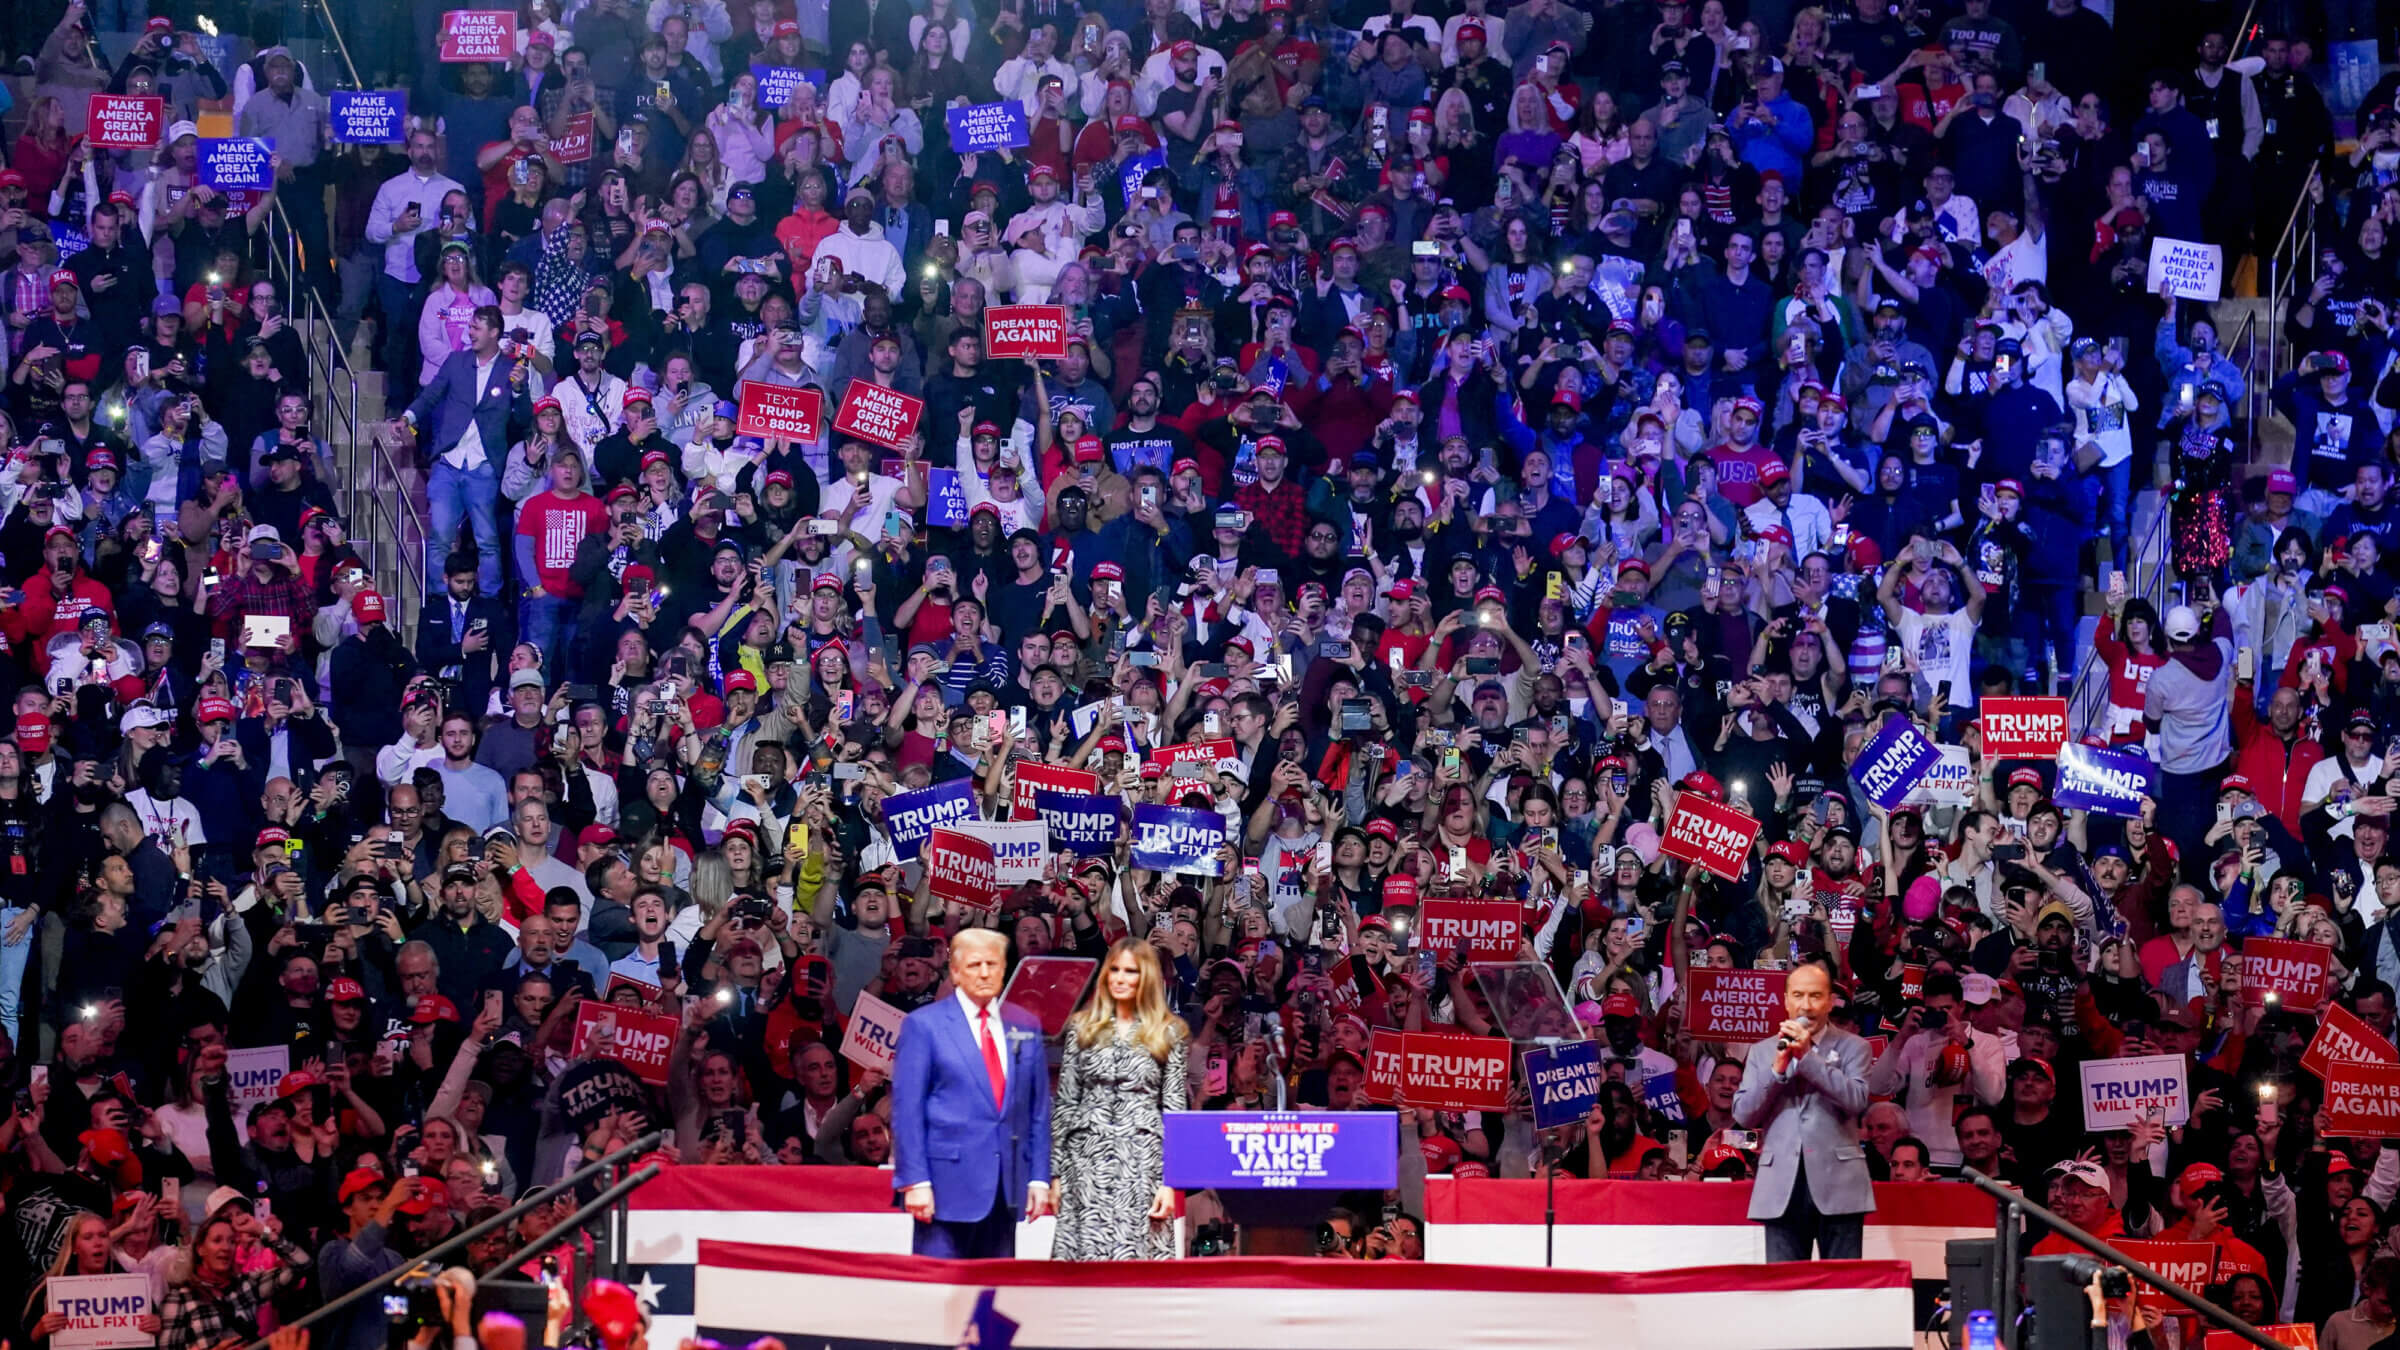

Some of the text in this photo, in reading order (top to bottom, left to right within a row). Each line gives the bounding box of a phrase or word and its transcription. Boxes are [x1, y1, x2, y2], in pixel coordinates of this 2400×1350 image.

[460, 16, 496, 25] MAKE
[450, 25, 507, 35] AMERICA
[1951, 29, 2001, 45] TOO BIG
[457, 35, 499, 45] GREAT
[456, 44, 500, 55] AGAIN!
[764, 95, 791, 104] AGA
[766, 88, 793, 97] GRE
[107, 100, 144, 111] MAKE
[350, 96, 386, 106] MAKE
[96, 109, 154, 121] AMERICA
[340, 106, 396, 116] AMERICA
[968, 106, 1004, 118] MAKE
[103, 121, 147, 131] GREAT
[347, 116, 389, 126] GREAT
[959, 114, 1016, 128] AMERICA
[101, 131, 147, 142] AGAIN!
[346, 126, 389, 137] AGAIN!
[967, 124, 1009, 135] GREAT
[968, 132, 1012, 145] AGAIN!
[217, 143, 254, 153] MAKE
[207, 153, 265, 163] AMERICA
[215, 163, 258, 174] GREAT
[214, 173, 260, 184] AGAIN!
[55, 238, 89, 252] AMER
[2172, 246, 2209, 260] MAKE
[2160, 255, 2215, 272] AMERICA
[2165, 266, 2208, 280] GREAT
[991, 319, 1061, 331] DREAM BIG,
[2335, 312, 2355, 326] 202
[995, 330, 1057, 344] AGAIN!
[765, 392, 799, 407] TEXT
[866, 388, 904, 408] MAKE
[757, 404, 805, 420] TRUMP
[852, 396, 909, 423] AMERICA
[747, 414, 811, 434] TO 88022
[856, 408, 898, 431] GREAT
[850, 419, 897, 441] AGAIN!
[1110, 439, 1172, 452] FIGHT FIGHT
[1718, 460, 1758, 485] USA
[565, 511, 576, 560] TRUMP
[2123, 657, 2153, 682] US
[1984, 713, 2064, 732] TRUMP
[1986, 730, 2063, 743] WILL FIX IT
[1173, 746, 1214, 762] MAKE
[1859, 729, 1916, 789] TRUMP
[1220, 761, 1239, 773] USA
[1869, 740, 1927, 801] WILL FIX IT
[1928, 764, 1968, 780] UMP
[1934, 779, 1969, 790] FIX IT
[2062, 777, 2099, 796] WILL
[2102, 785, 2128, 800] FIX
[888, 797, 970, 832] TRUMP
[1038, 808, 1116, 831] TRUMP
[894, 828, 929, 843] WILL
[1070, 829, 1114, 842] FIX IT
[1138, 822, 1223, 846] TRUMP
[1676, 808, 1750, 850] TRUMP
[995, 841, 1041, 858] UMP
[1178, 845, 1205, 858] FIX
[1670, 825, 1742, 863] WILL FIX IT
[1770, 843, 1790, 854] USA
[935, 847, 996, 883] TRUMP
[1000, 858, 1041, 870] FIX IT
[933, 867, 996, 894] WILL FIX IT
[1426, 918, 1517, 938] TRUMP
[1427, 936, 1515, 951] WIL FIX IT
[2244, 955, 2322, 982] TRUMP
[1715, 975, 1766, 991] MAKE
[2241, 975, 2319, 995] WILL FIX IT
[1700, 990, 1780, 1006] AMERICA
[1710, 1004, 1769, 1020] GREAT
[859, 1015, 897, 1050] TRU
[1707, 1018, 1770, 1034] AGAIN!
[582, 1020, 670, 1054] TUMP
[854, 1031, 884, 1059] WILL
[621, 1048, 667, 1066] FIX IT
[1407, 1051, 1505, 1077] TRUMP
[233, 1068, 282, 1088] UMP
[1407, 1072, 1504, 1092] WILL FIX IT
[1535, 1063, 1586, 1086] DREAM
[243, 1086, 267, 1099] FIX
[2091, 1077, 2178, 1101] TRUMP
[2331, 1081, 2385, 1097] DREAM
[568, 1092, 606, 1117] WILL
[1443, 1100, 1464, 1108] 2024
[2092, 1098, 2131, 1113] WILL
[2162, 1094, 2178, 1108] IT
[1269, 1122, 1299, 1133] WILL
[1300, 1122, 1320, 1133] FIX
[1320, 1122, 1335, 1133] IT
[1225, 1133, 1335, 1154] TRUMP
[1237, 1152, 1322, 1170] VANCE
[1714, 1148, 1737, 1158] USA
[1262, 1175, 1298, 1187] 2024
[57, 1295, 145, 1317] TRUMP
[102, 1314, 128, 1328] FIX
